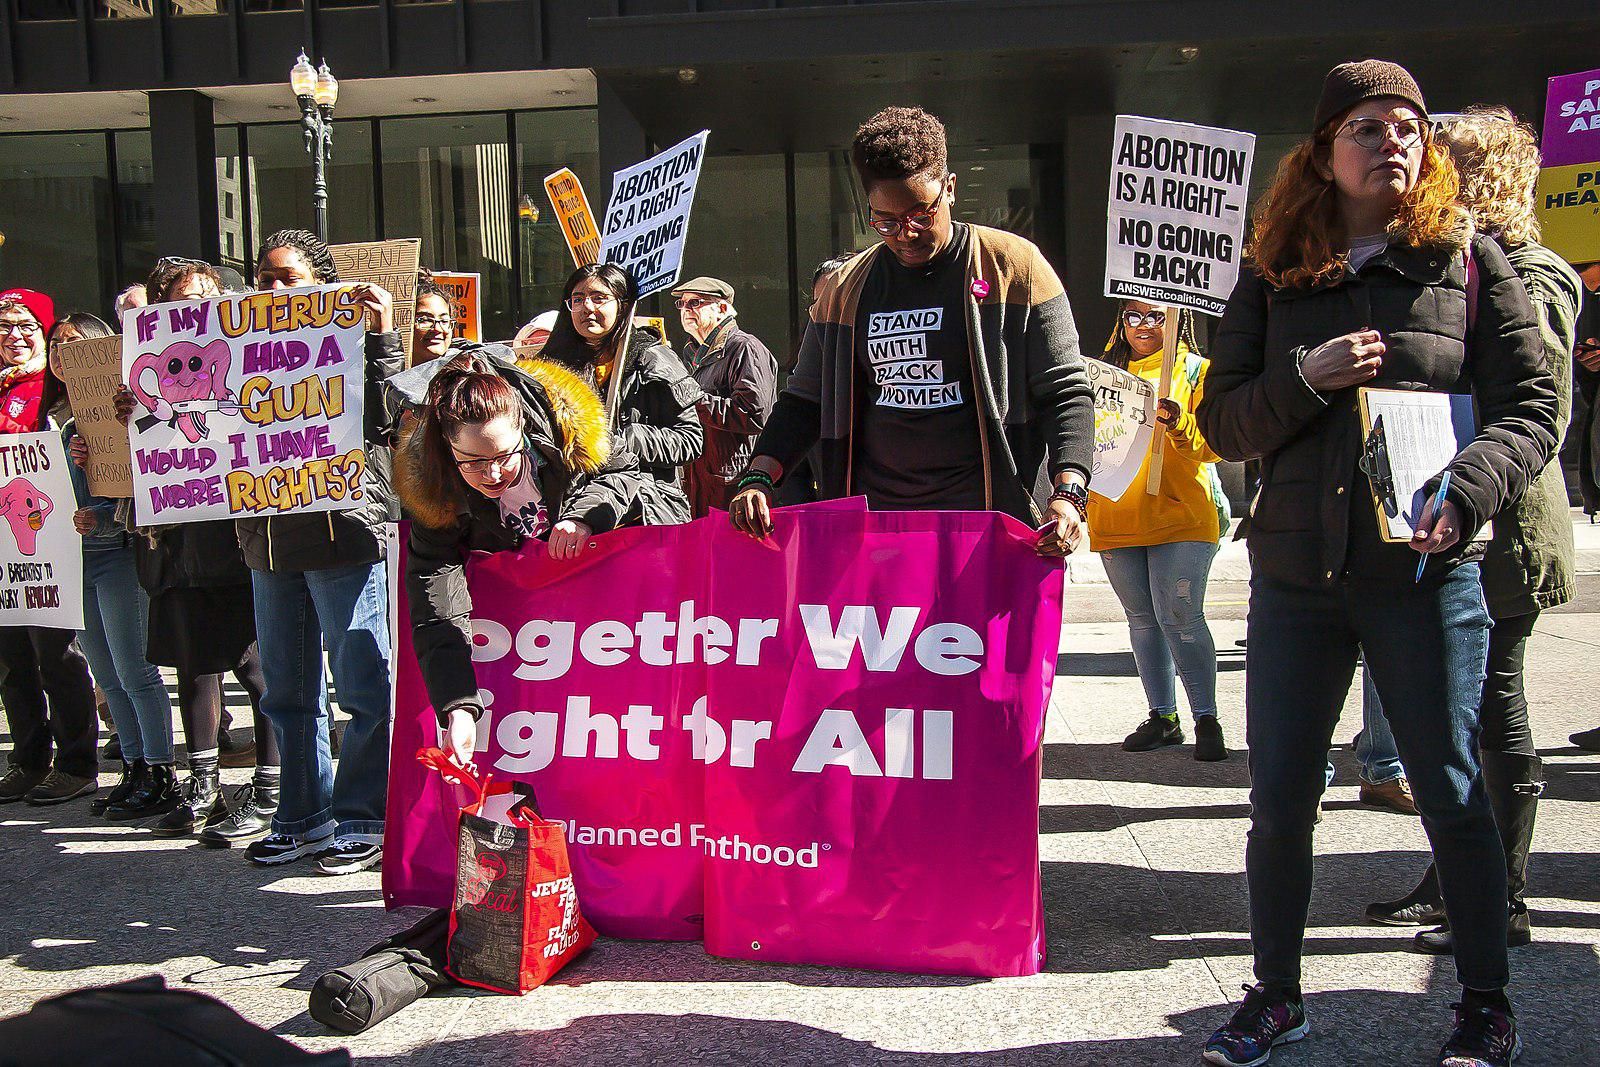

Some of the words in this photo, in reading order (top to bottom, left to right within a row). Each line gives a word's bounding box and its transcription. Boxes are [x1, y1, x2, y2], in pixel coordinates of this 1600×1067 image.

[1560, 97, 1600, 117] SA
[612, 144, 700, 208] ABORTION
[1117, 132, 1246, 186] ABORTION
[1116, 171, 1137, 203] IS
[1140, 175, 1157, 206] A
[568, 211, 591, 241] OUT
[606, 209, 622, 236] IS
[623, 202, 636, 230] A
[344, 244, 409, 270] SPENT
[605, 241, 630, 266] NO
[630, 214, 684, 260] GOING
[1118, 217, 1153, 248] NO
[1157, 223, 1233, 264] GOING
[1133, 251, 1211, 290] BACK!
[136, 309, 161, 346] IF
[168, 299, 210, 338] MY
[217, 286, 364, 338] UTERUS
[1116, 282, 1226, 313] ANSWERcoalition.org
[871, 311, 938, 333] STAND
[62, 338, 122, 370] EXPENSIVE
[242, 338, 310, 377] HAD
[313, 333, 345, 370] A
[870, 337, 924, 360] WITH
[877, 363, 939, 383] BLACK
[240, 374, 347, 429] GUN
[881, 385, 958, 406] WOMEN
[135, 446, 218, 476] WOULD
[228, 433, 250, 468] I
[257, 425, 336, 464] HAVE
[149, 475, 226, 515] MORE
[226, 448, 365, 515] RIGHTS?
[471, 600, 779, 681] ogether
[798, 603, 985, 676] We
[436, 688, 664, 774] ight
[791, 708, 954, 780] All
